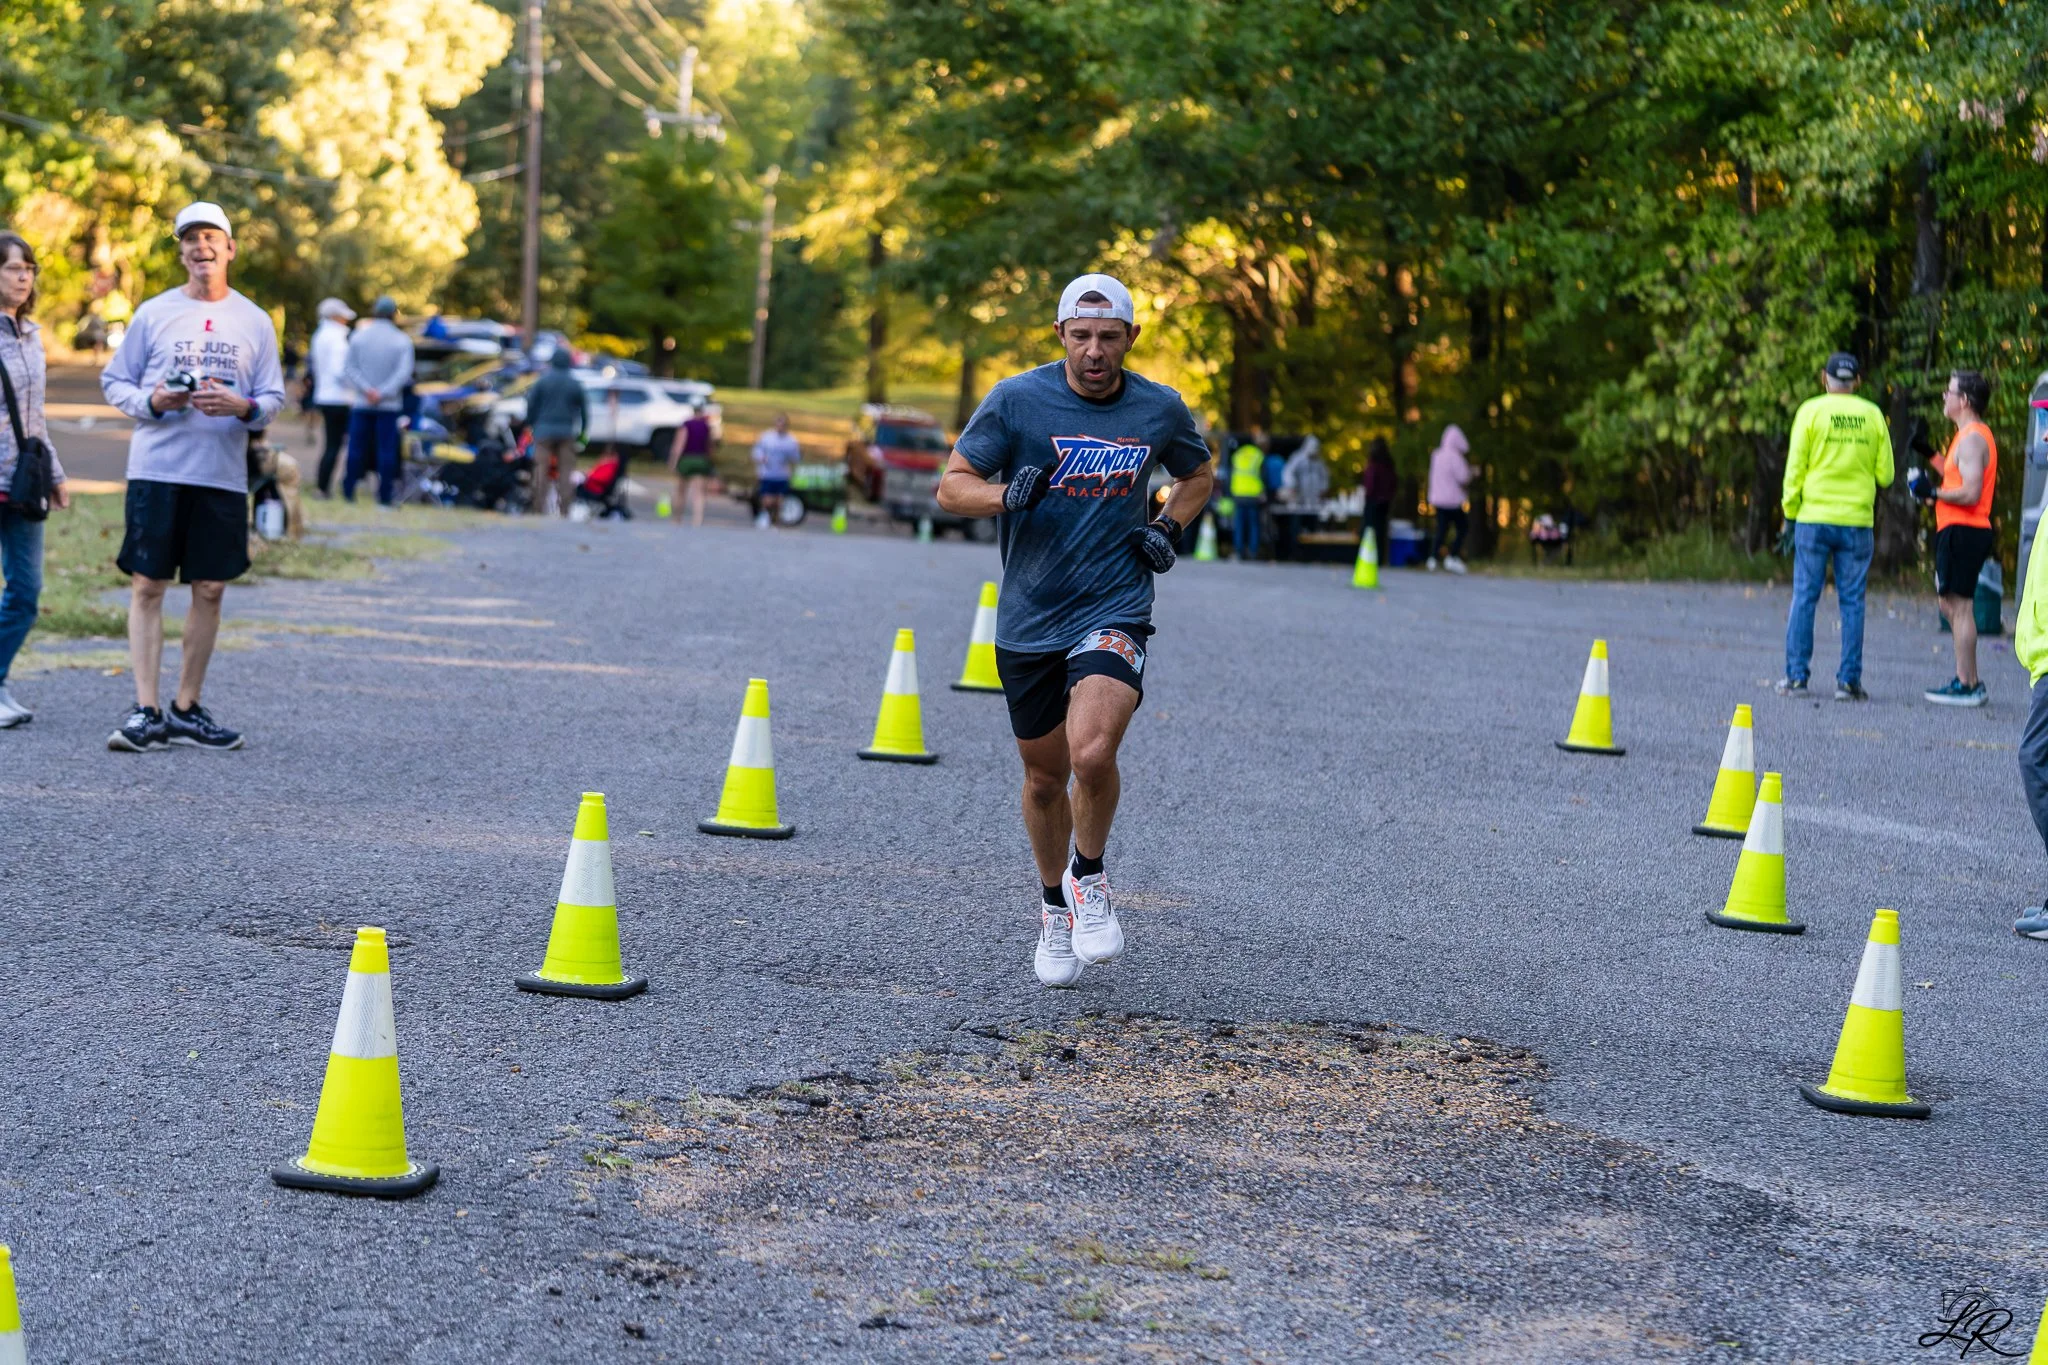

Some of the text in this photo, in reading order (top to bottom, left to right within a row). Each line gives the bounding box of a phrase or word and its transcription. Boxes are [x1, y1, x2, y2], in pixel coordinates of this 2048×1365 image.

[174, 341, 240, 357] ST. JUDE
[174, 356, 240, 370] MEMPHIS
[1050, 436, 1150, 488] THUNDER
[1067, 486, 1128, 497] RACING
